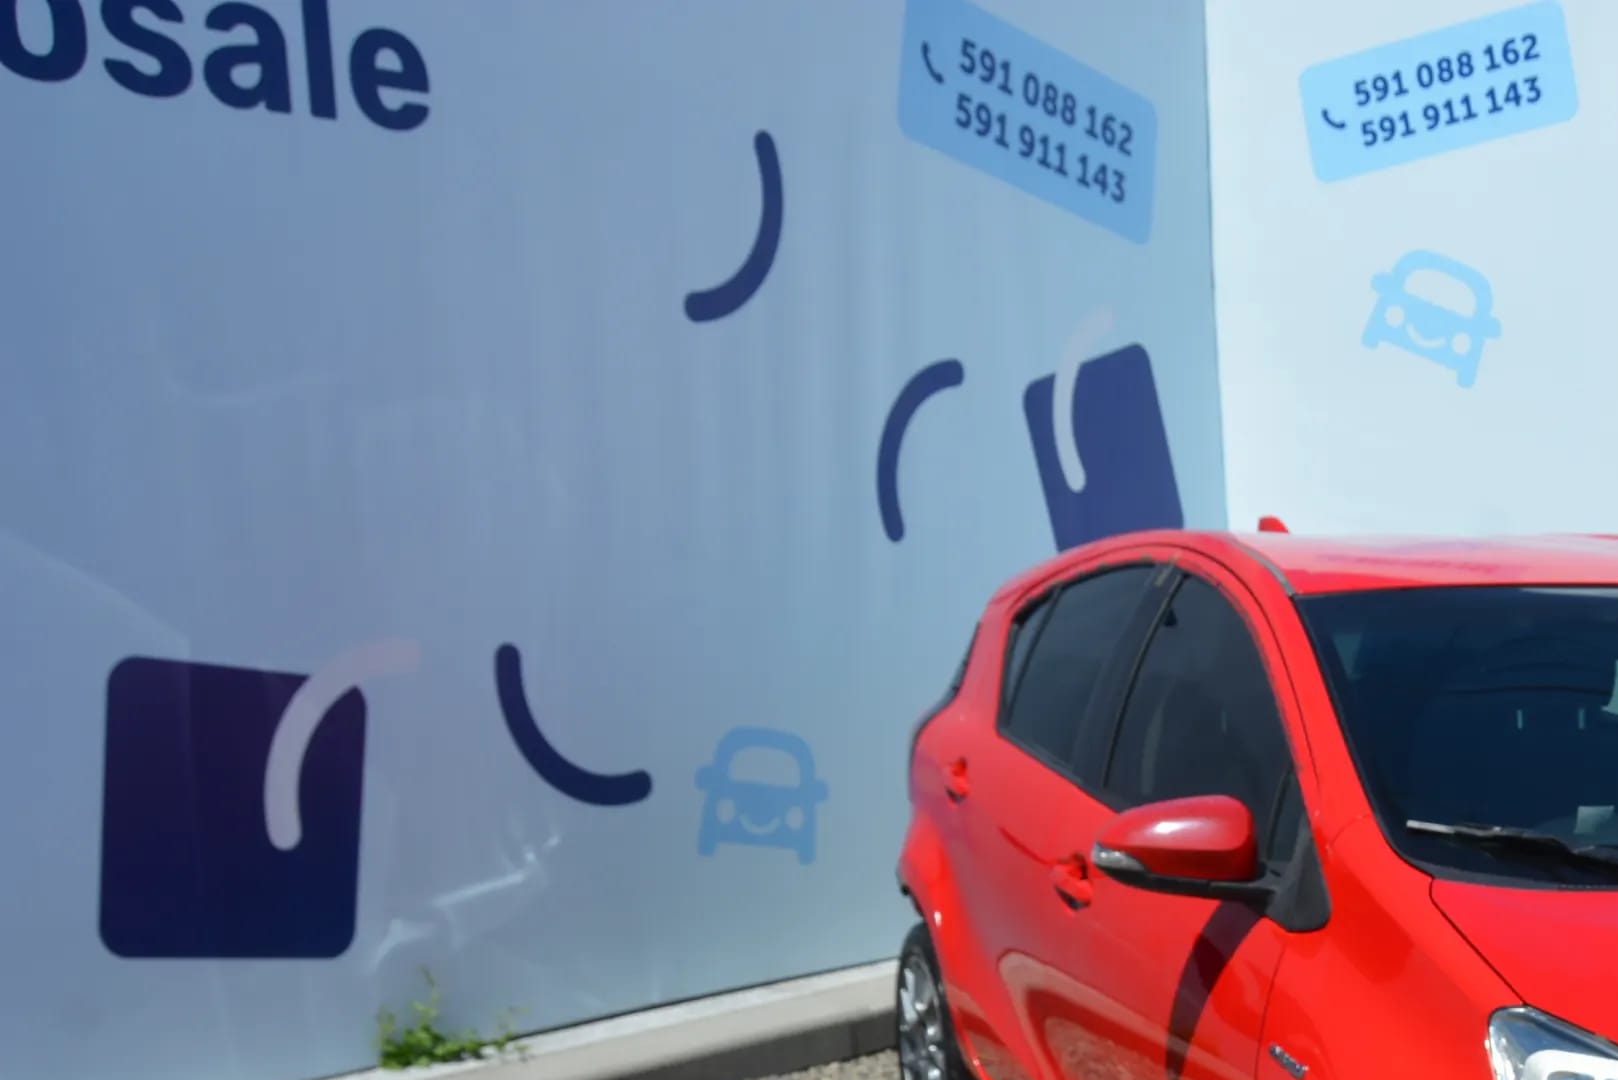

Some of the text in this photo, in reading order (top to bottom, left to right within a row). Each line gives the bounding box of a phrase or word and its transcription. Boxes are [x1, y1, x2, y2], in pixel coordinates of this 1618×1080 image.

[959, 38, 1133, 157] 591 088 162
[1353, 34, 1541, 107] 591 088 162
[1360, 76, 1542, 147] 591 911 143
[954, 92, 1126, 204] 591 911 143
